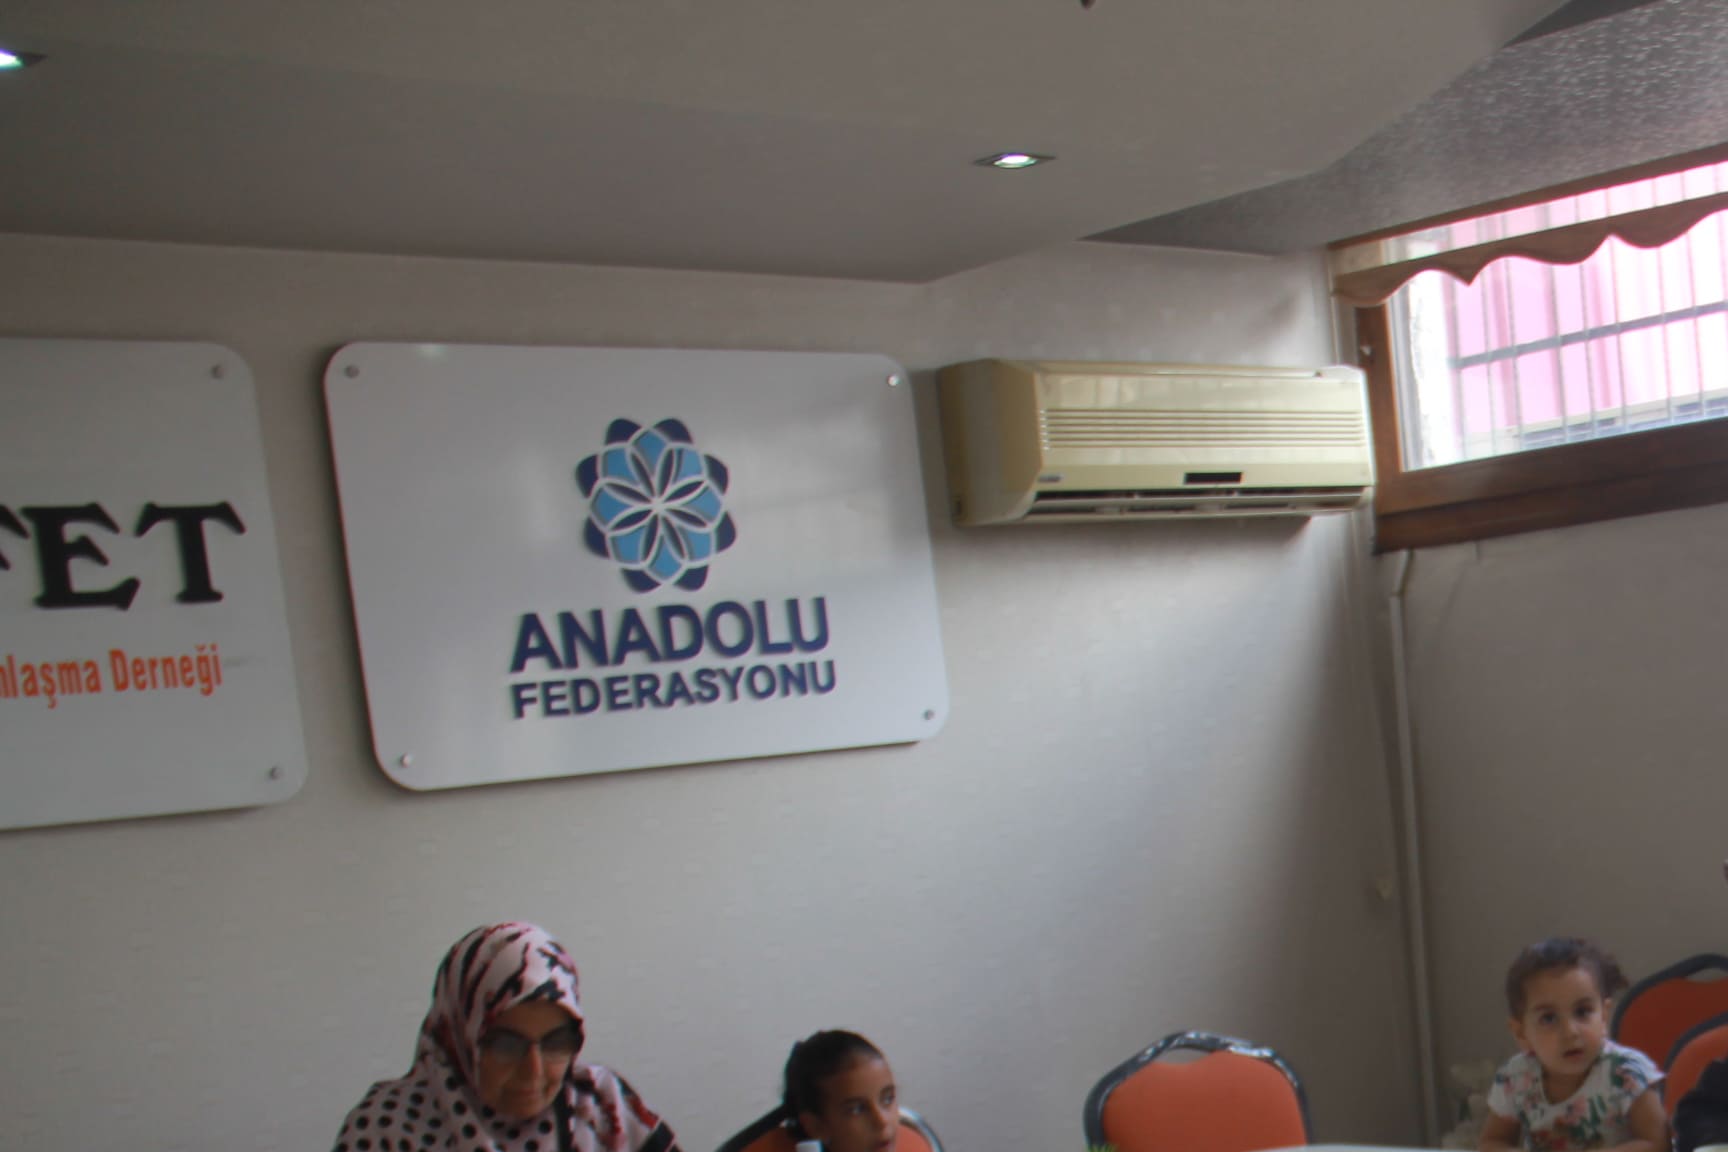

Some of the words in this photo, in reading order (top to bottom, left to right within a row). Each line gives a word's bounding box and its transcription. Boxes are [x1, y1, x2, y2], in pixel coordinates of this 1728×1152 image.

[508, 596, 830, 674] ANADOLU
[109, 644, 222, 696] Derneği
[510, 660, 837, 721] FEDERASYONU
